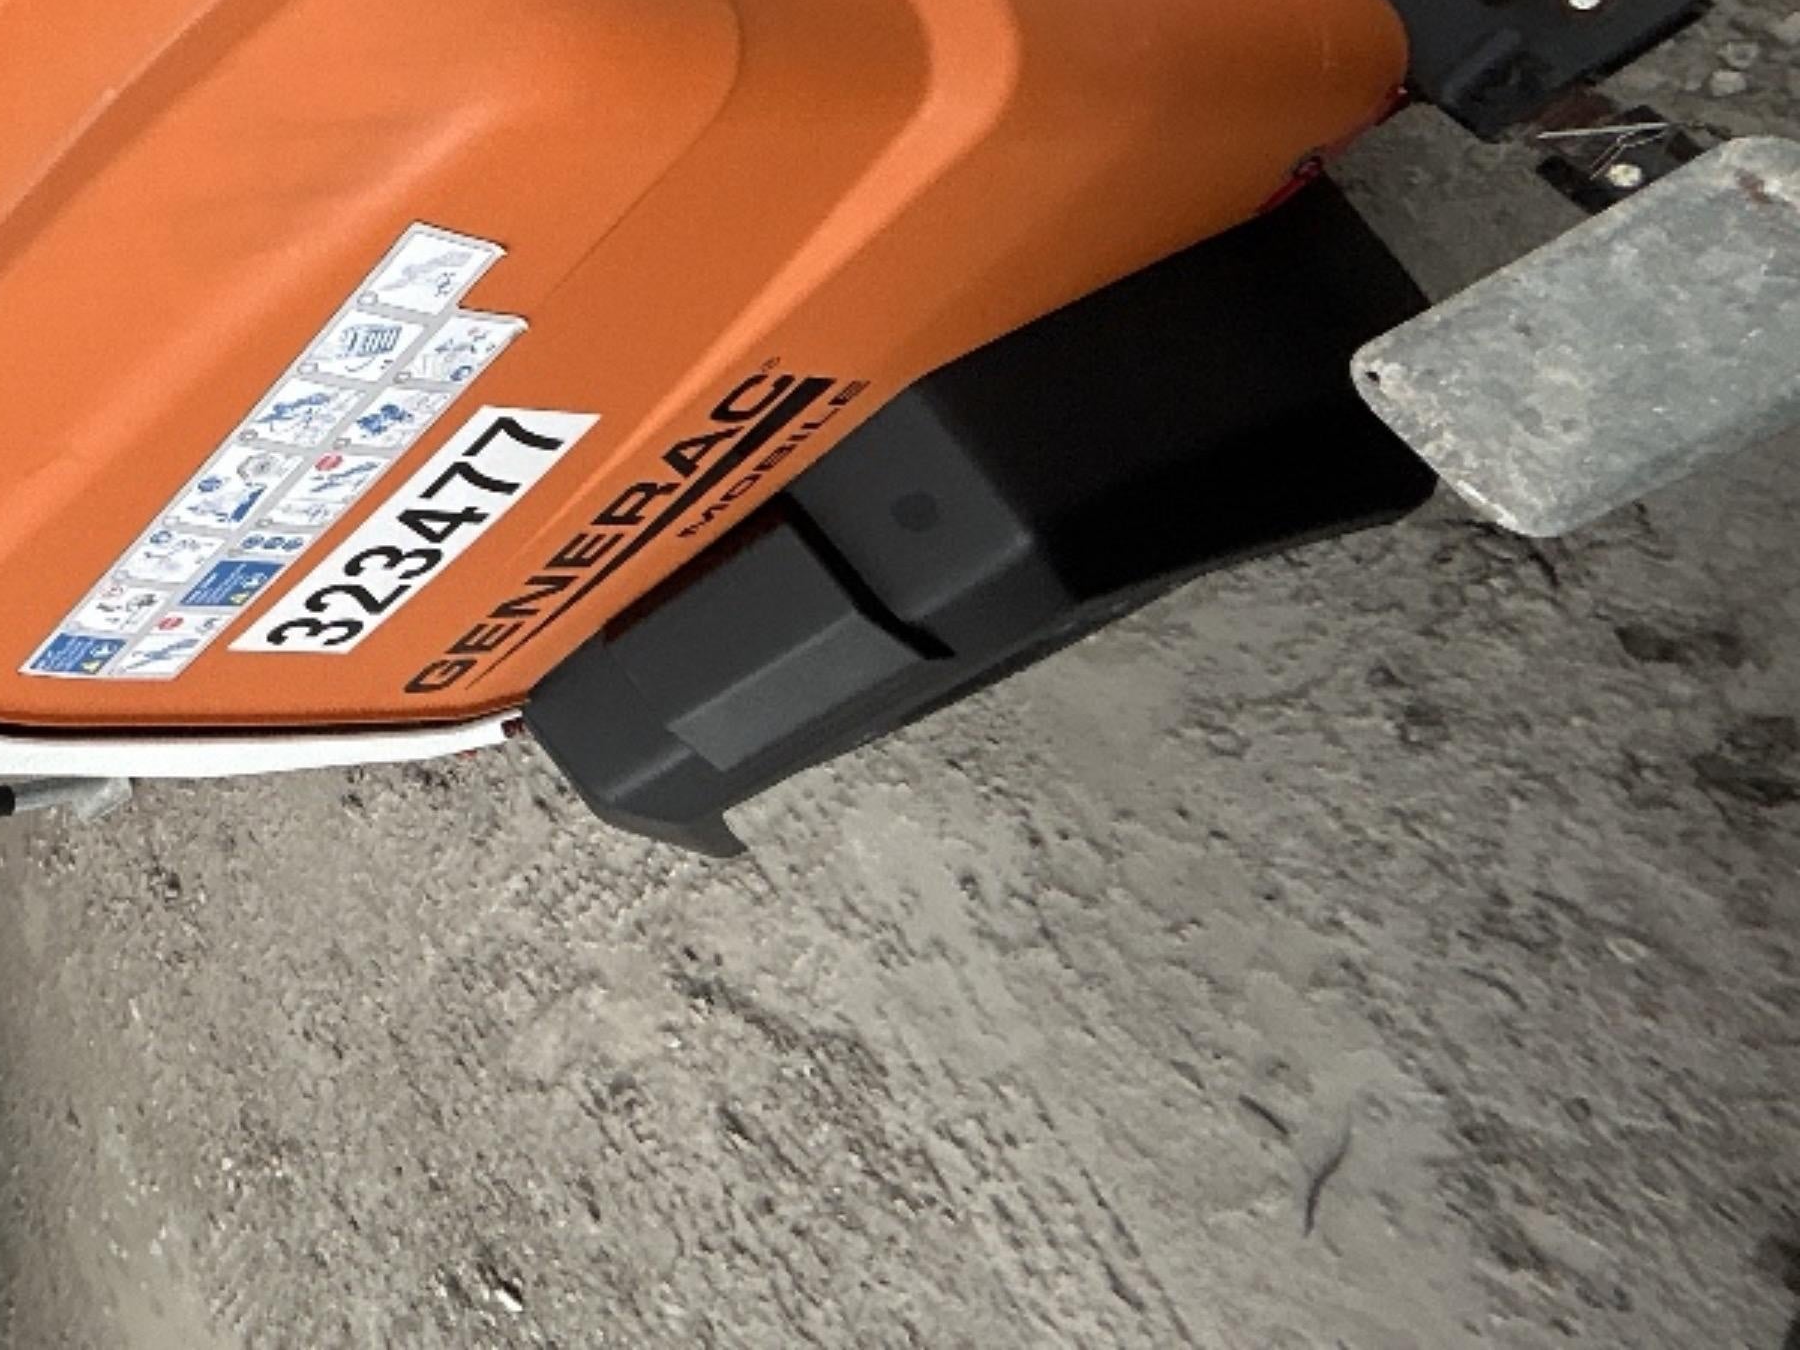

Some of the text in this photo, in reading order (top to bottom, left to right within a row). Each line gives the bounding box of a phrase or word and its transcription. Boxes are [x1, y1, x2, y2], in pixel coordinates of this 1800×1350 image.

[266, 416, 564, 646] 323477
[403, 372, 797, 695] GENERAC
[677, 378, 871, 539] MOBILE
